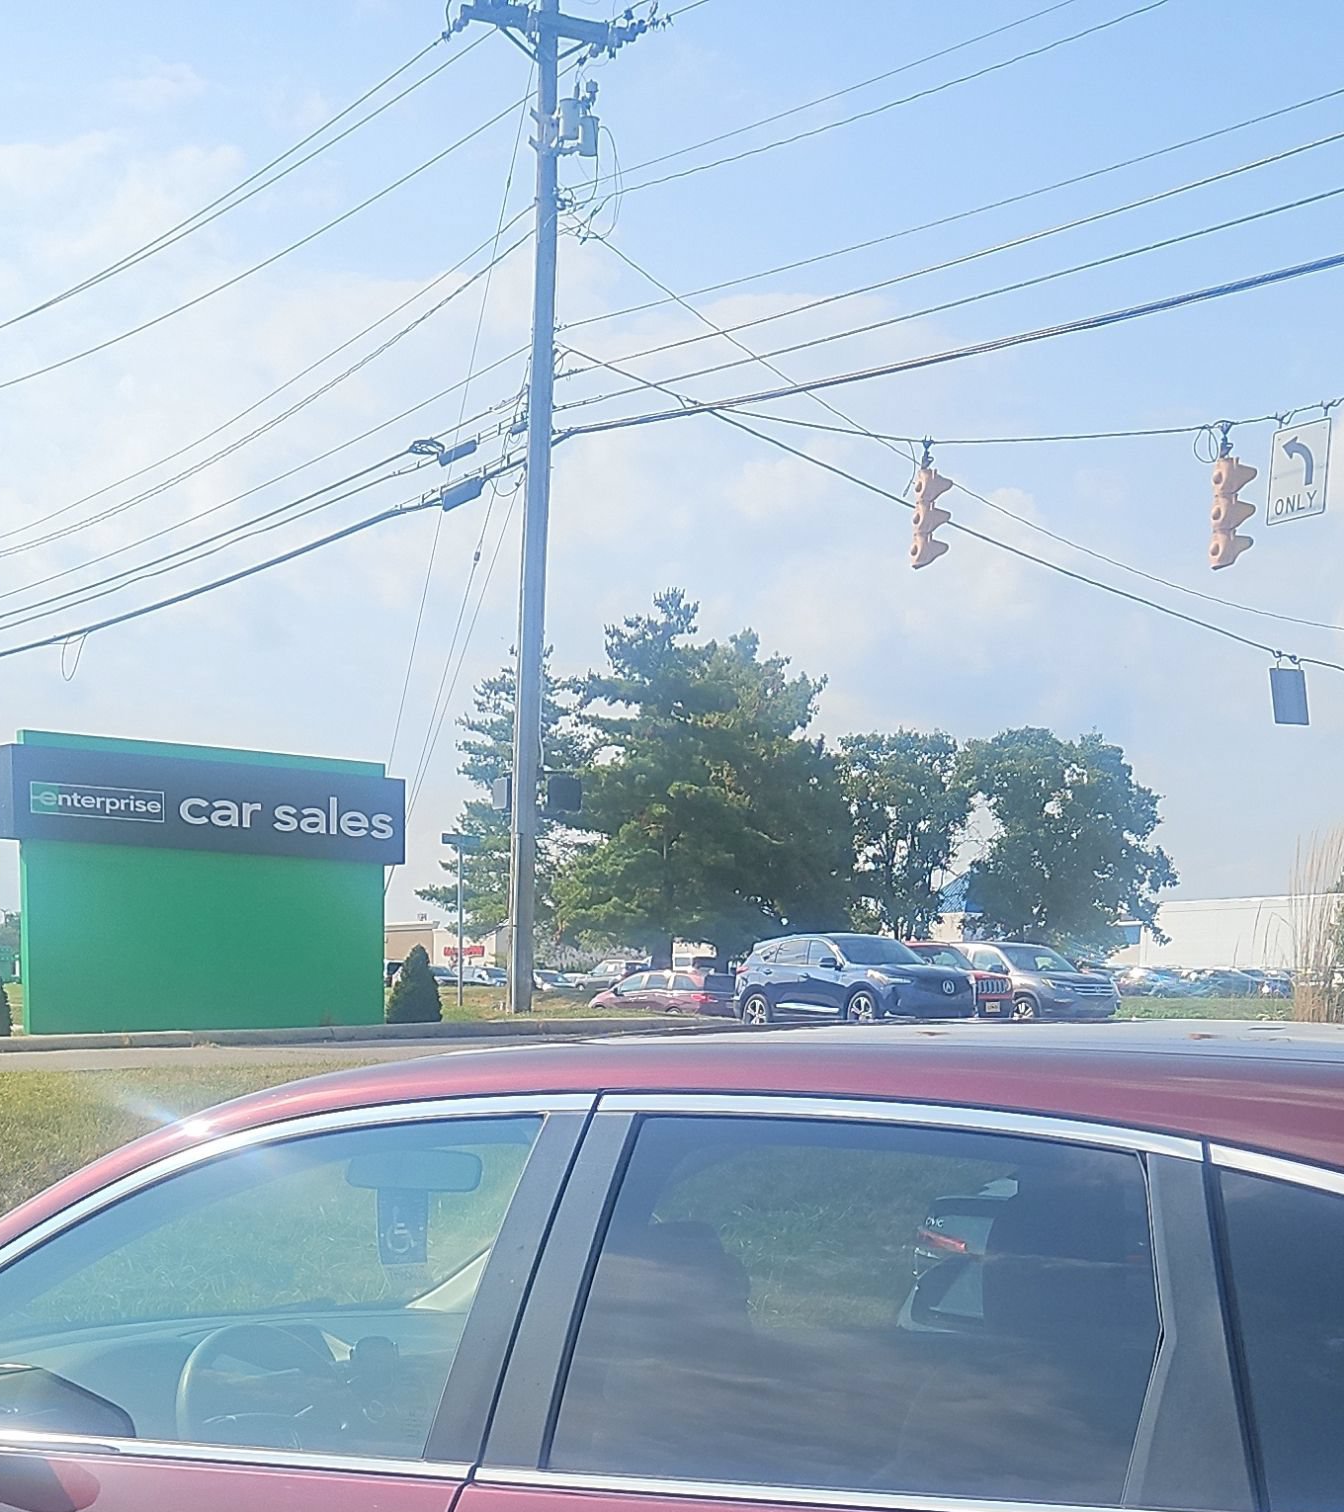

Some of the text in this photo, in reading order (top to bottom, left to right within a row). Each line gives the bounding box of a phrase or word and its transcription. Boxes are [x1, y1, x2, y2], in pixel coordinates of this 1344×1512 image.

[1274, 490, 1317, 515] ONLY
[38, 791, 394, 840] enterprise car sales
